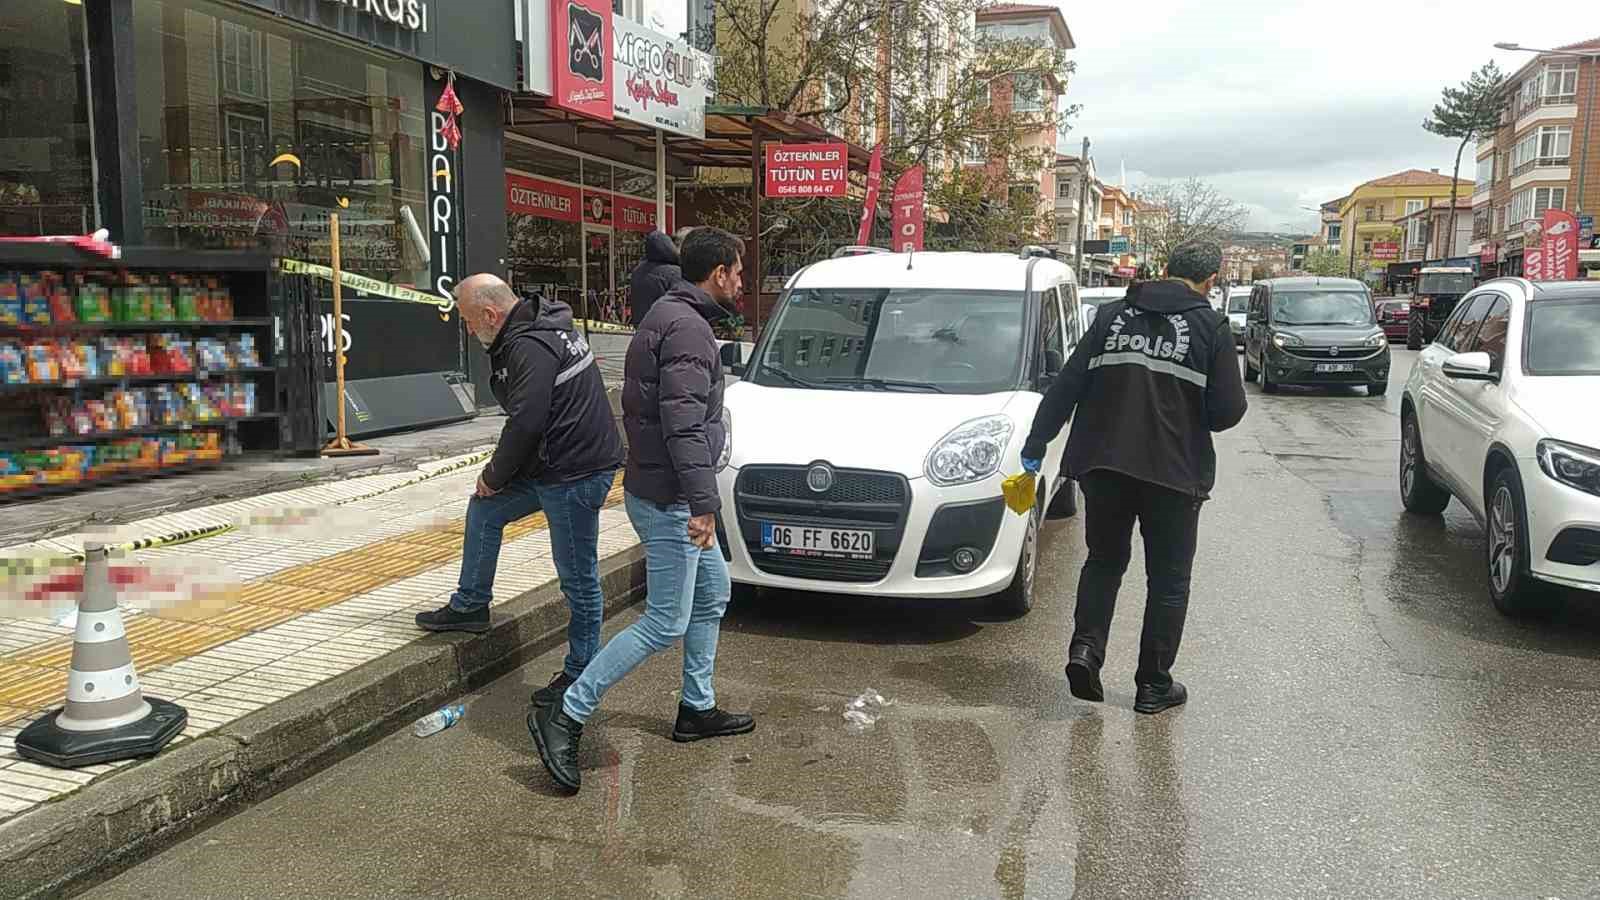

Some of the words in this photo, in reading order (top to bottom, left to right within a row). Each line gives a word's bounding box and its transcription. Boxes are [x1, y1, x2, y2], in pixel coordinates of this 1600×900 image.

[774, 149, 840, 162] ÖZTEKİNLER
[769, 166, 815, 182] TÜTÜN
[822, 165, 843, 181] EVİ
[510, 183, 571, 213] ÖZTEKİNLER
[778, 185, 797, 194] 0545
[824, 185, 835, 193] 47
[622, 205, 647, 225] TÜTÜN
[773, 527, 793, 546] 06
[802, 529, 822, 548] FF
[830, 531, 871, 552] 6620
